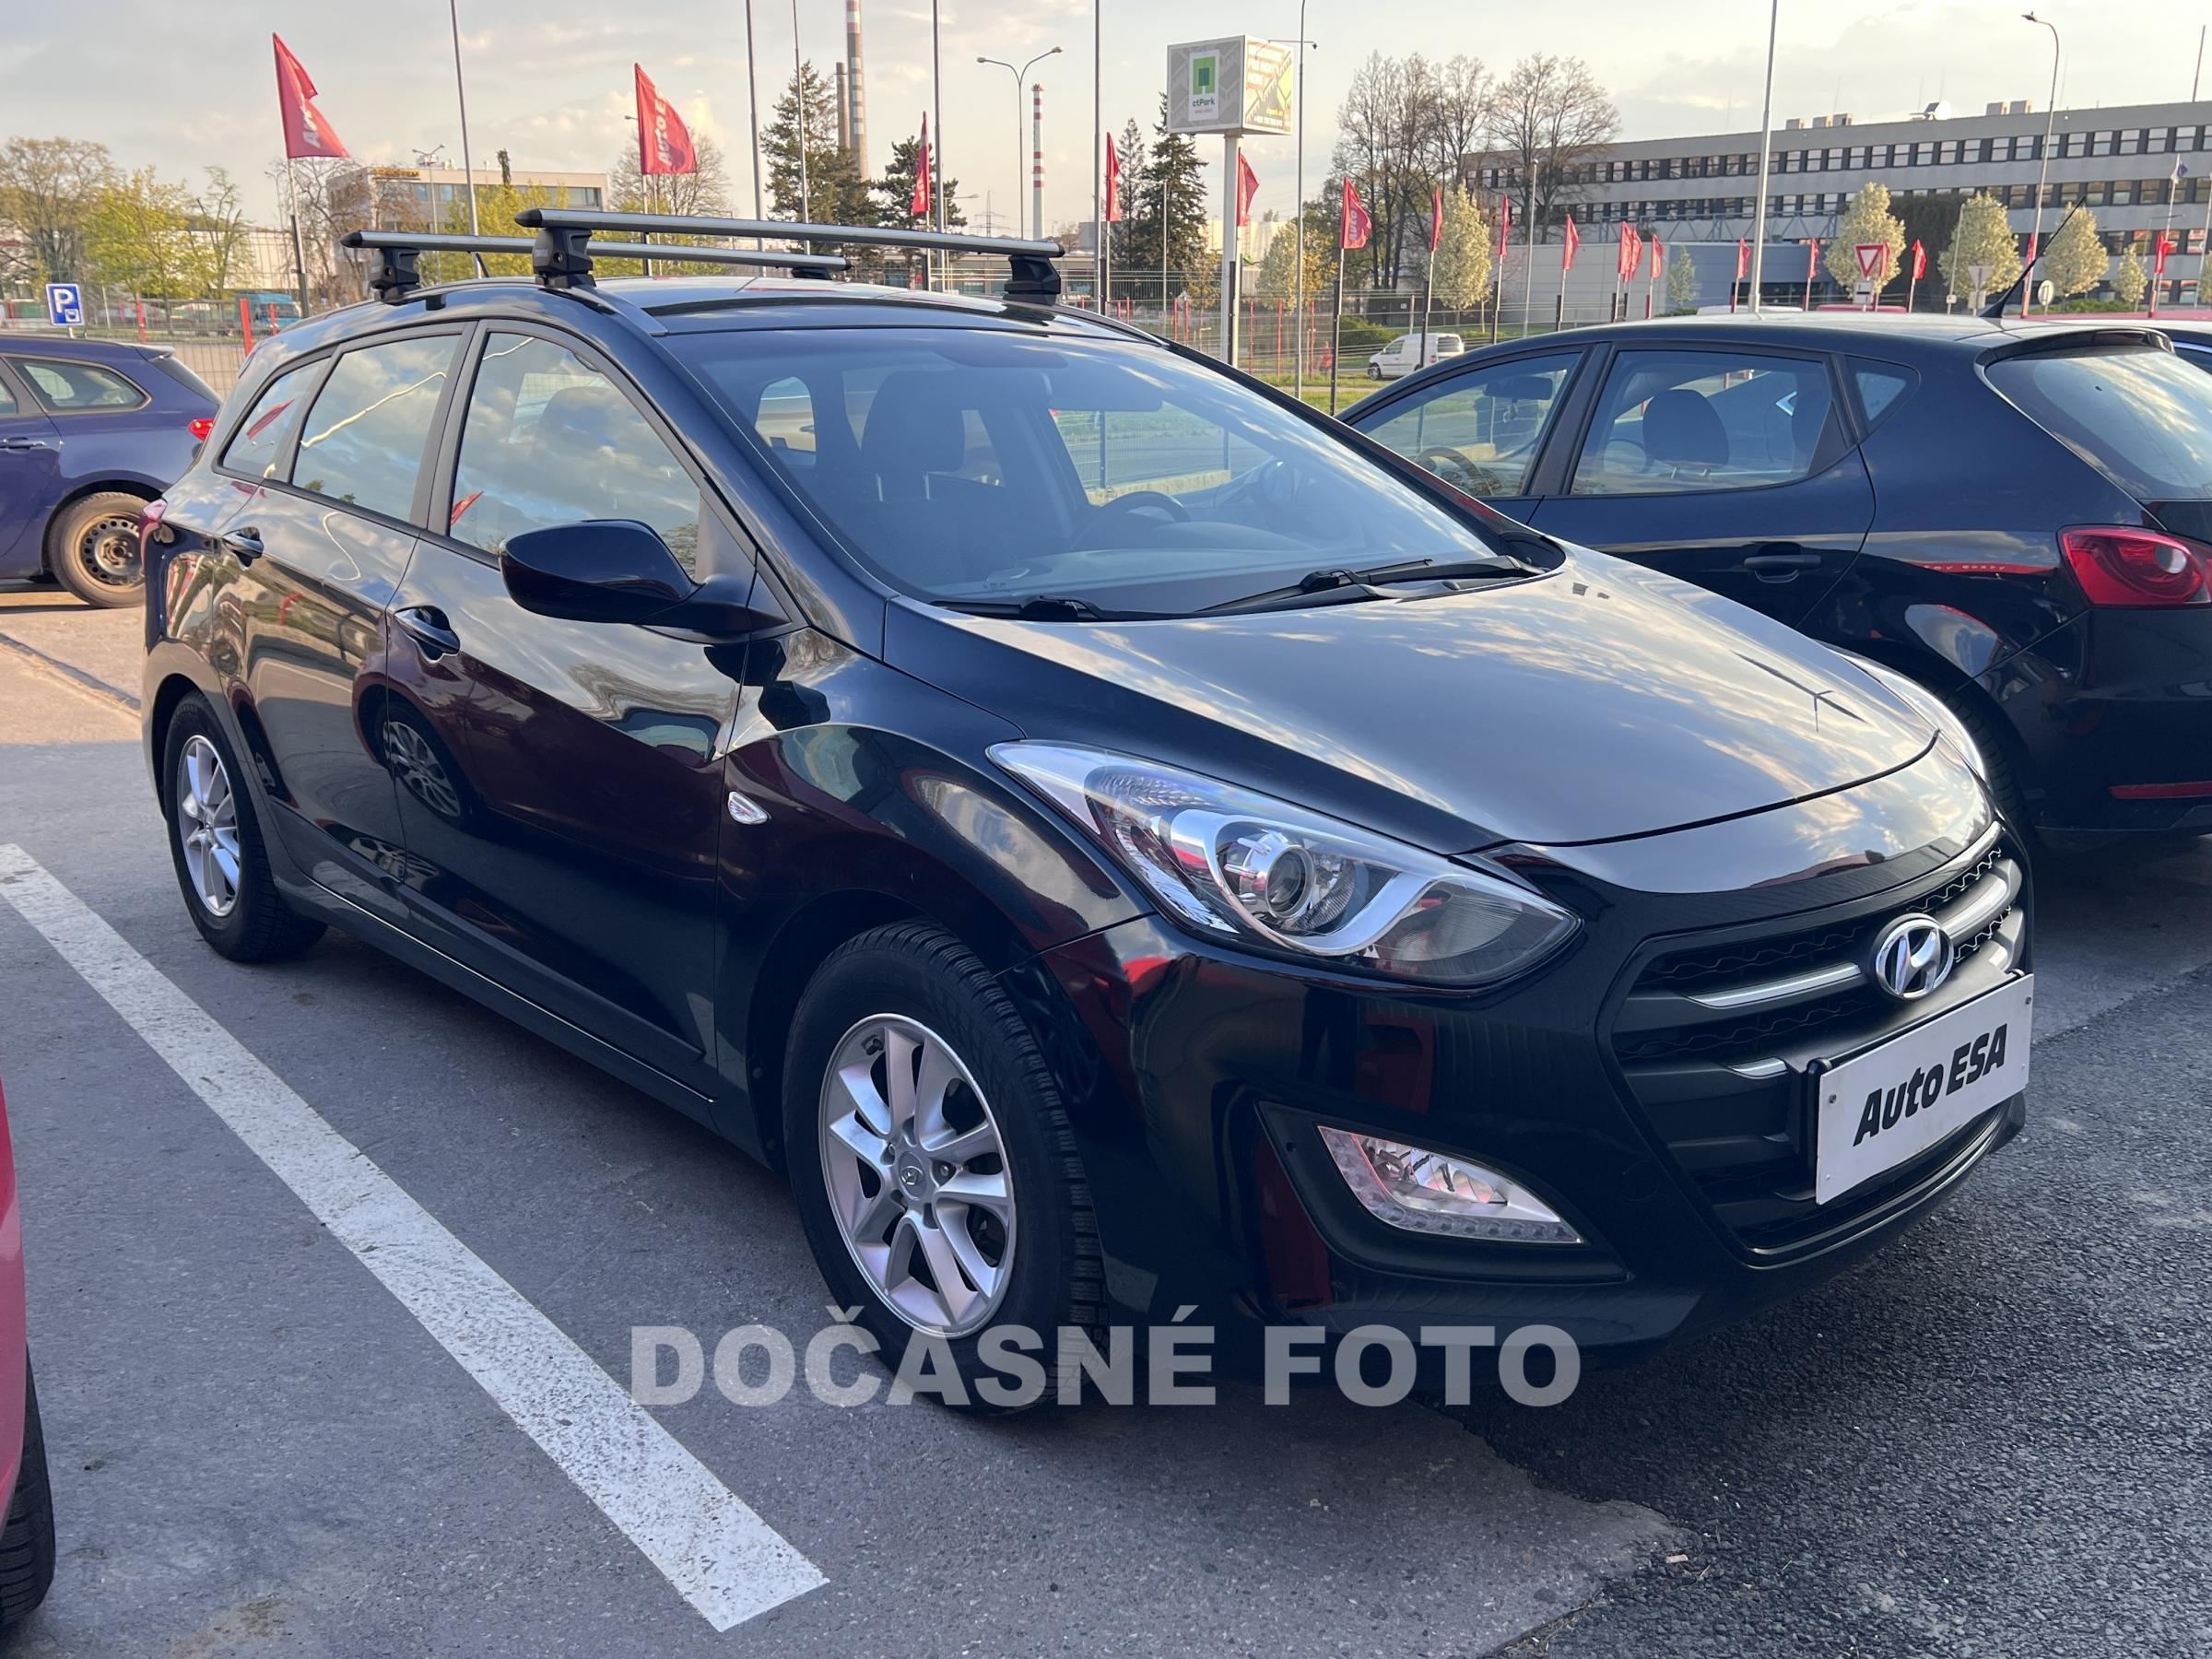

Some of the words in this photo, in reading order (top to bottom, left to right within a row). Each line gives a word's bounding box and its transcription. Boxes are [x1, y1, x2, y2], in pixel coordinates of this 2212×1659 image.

[1192, 98, 1216, 107] ctPark
[53, 288, 74, 313] P
[1853, 1065, 1945, 1147] Auto
[1946, 1023, 2007, 1096] ESA
